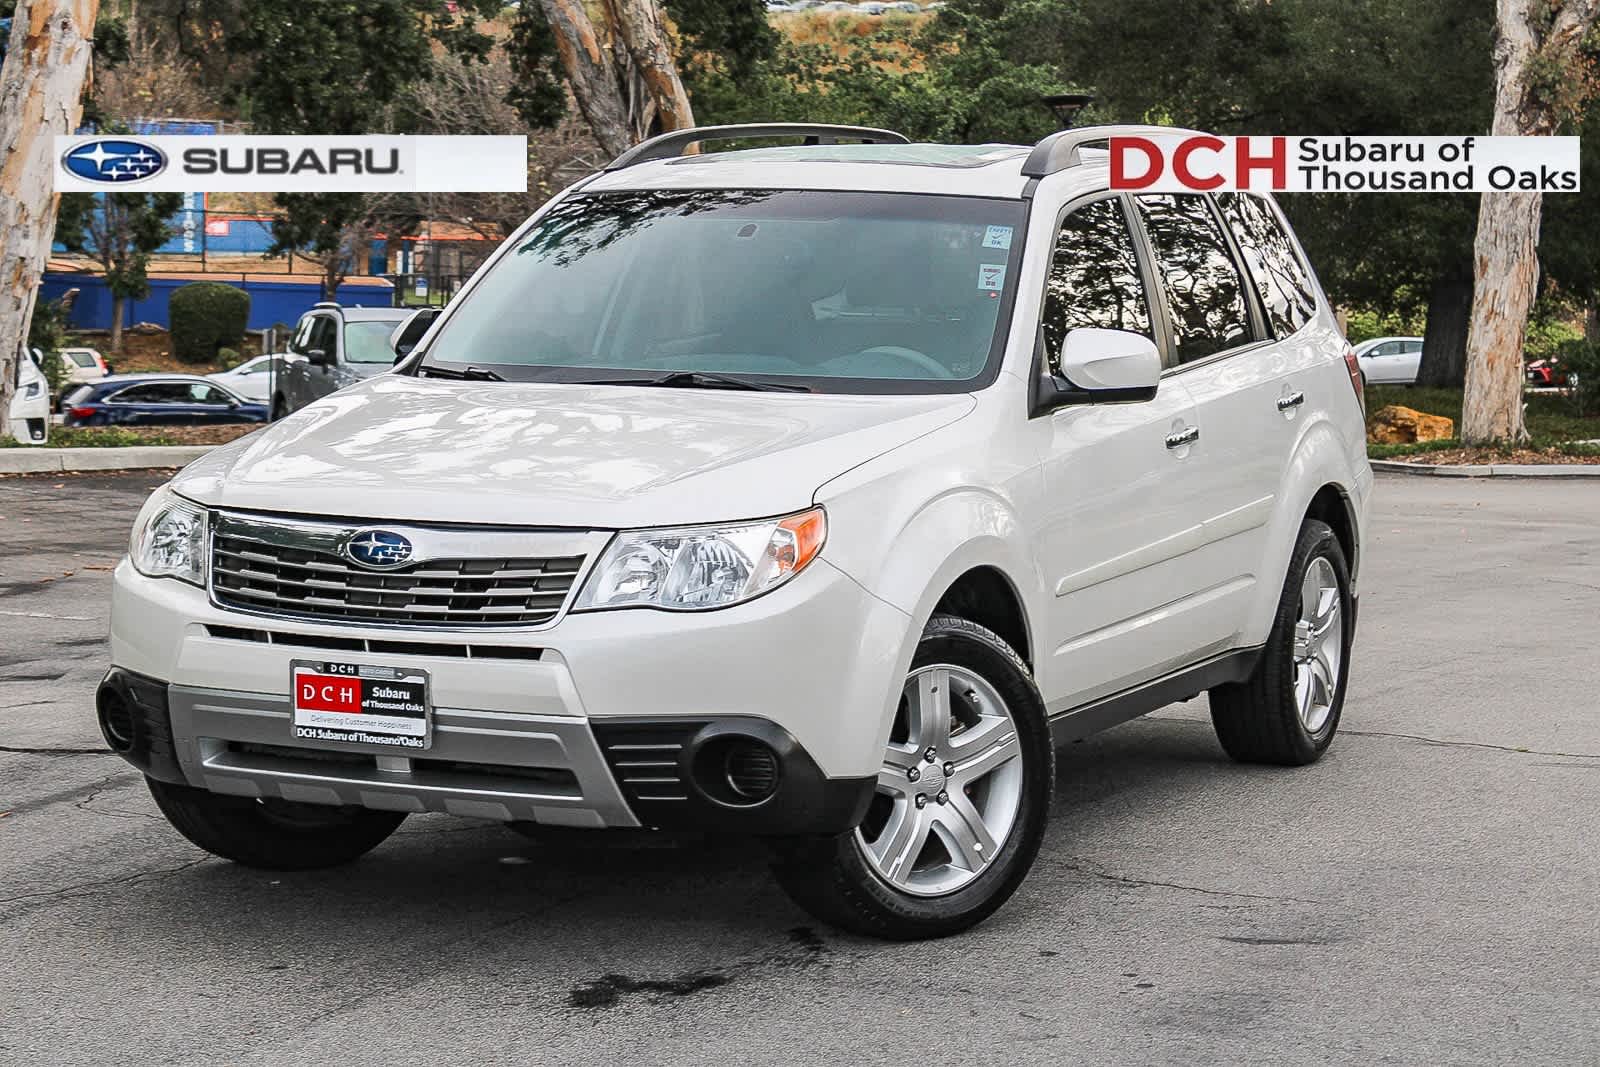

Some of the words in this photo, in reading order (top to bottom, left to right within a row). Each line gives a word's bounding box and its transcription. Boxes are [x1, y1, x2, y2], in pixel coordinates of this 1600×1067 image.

[372, 687, 410, 699] Subaru
[361, 699, 370, 708] of
[370, 700, 405, 710] Thousand
[405, 703, 424, 711] Oaks
[344, 717, 377, 727] Customer
[297, 728, 317, 738] DCH
[317, 729, 348, 742] Subaru
[348, 732, 357, 742] of
[357, 733, 400, 745] Thousand
[400, 736, 424, 747] Oaks
